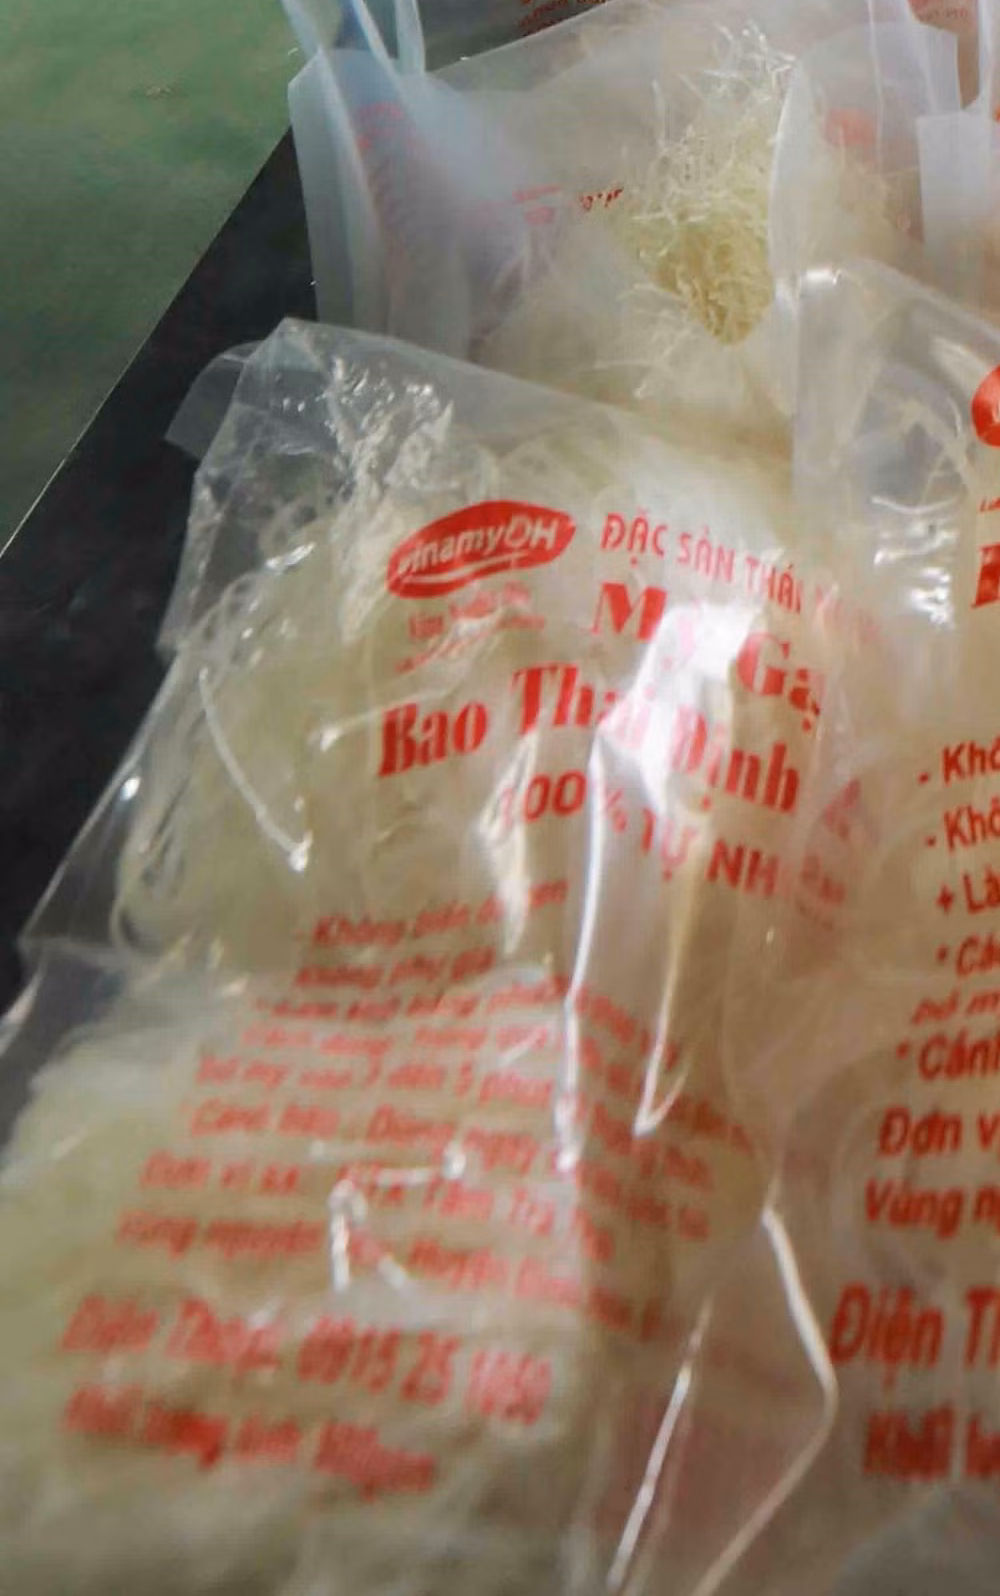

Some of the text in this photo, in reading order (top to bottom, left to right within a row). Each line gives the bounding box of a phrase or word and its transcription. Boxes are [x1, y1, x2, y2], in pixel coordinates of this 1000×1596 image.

[601, 509, 669, 569] ĐẶC
[378, 700, 489, 779] Bao
[878, 1105, 963, 1159] Đơn
[864, 1175, 965, 1241] Vùng
[830, 1282, 945, 1388] Điện
